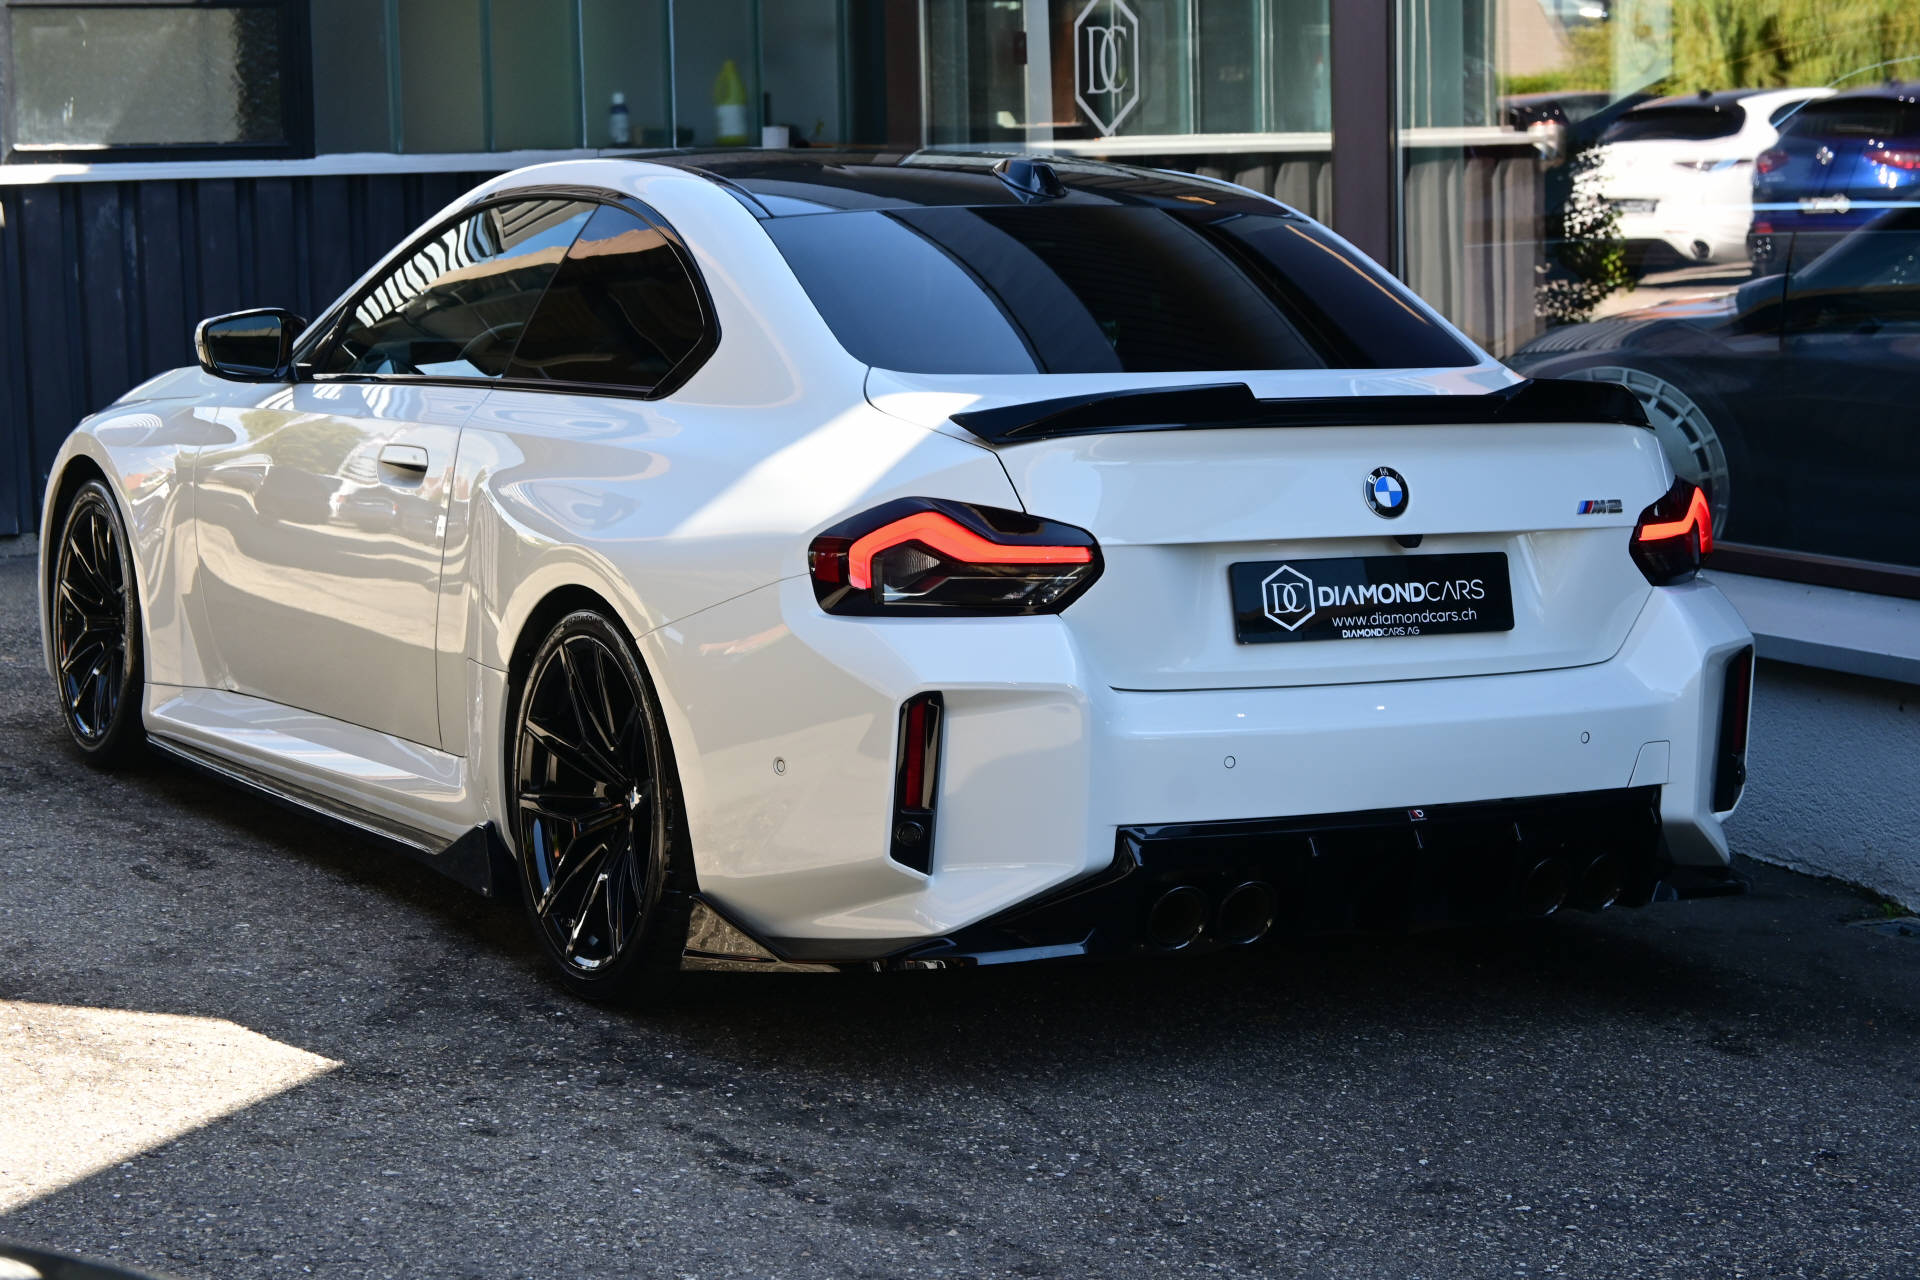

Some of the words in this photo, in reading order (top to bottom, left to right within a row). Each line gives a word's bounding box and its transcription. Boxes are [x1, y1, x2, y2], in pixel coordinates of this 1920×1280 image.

[1086, 26, 1128, 94] DC
[1271, 582, 1306, 614] DC
[1317, 579, 1485, 607] DIAMONDCARS
[1331, 608, 1477, 627] www.diamondcars.ch
[1341, 626, 1405, 639] DIAMONDCARS
[1407, 626, 1420, 636] AG
